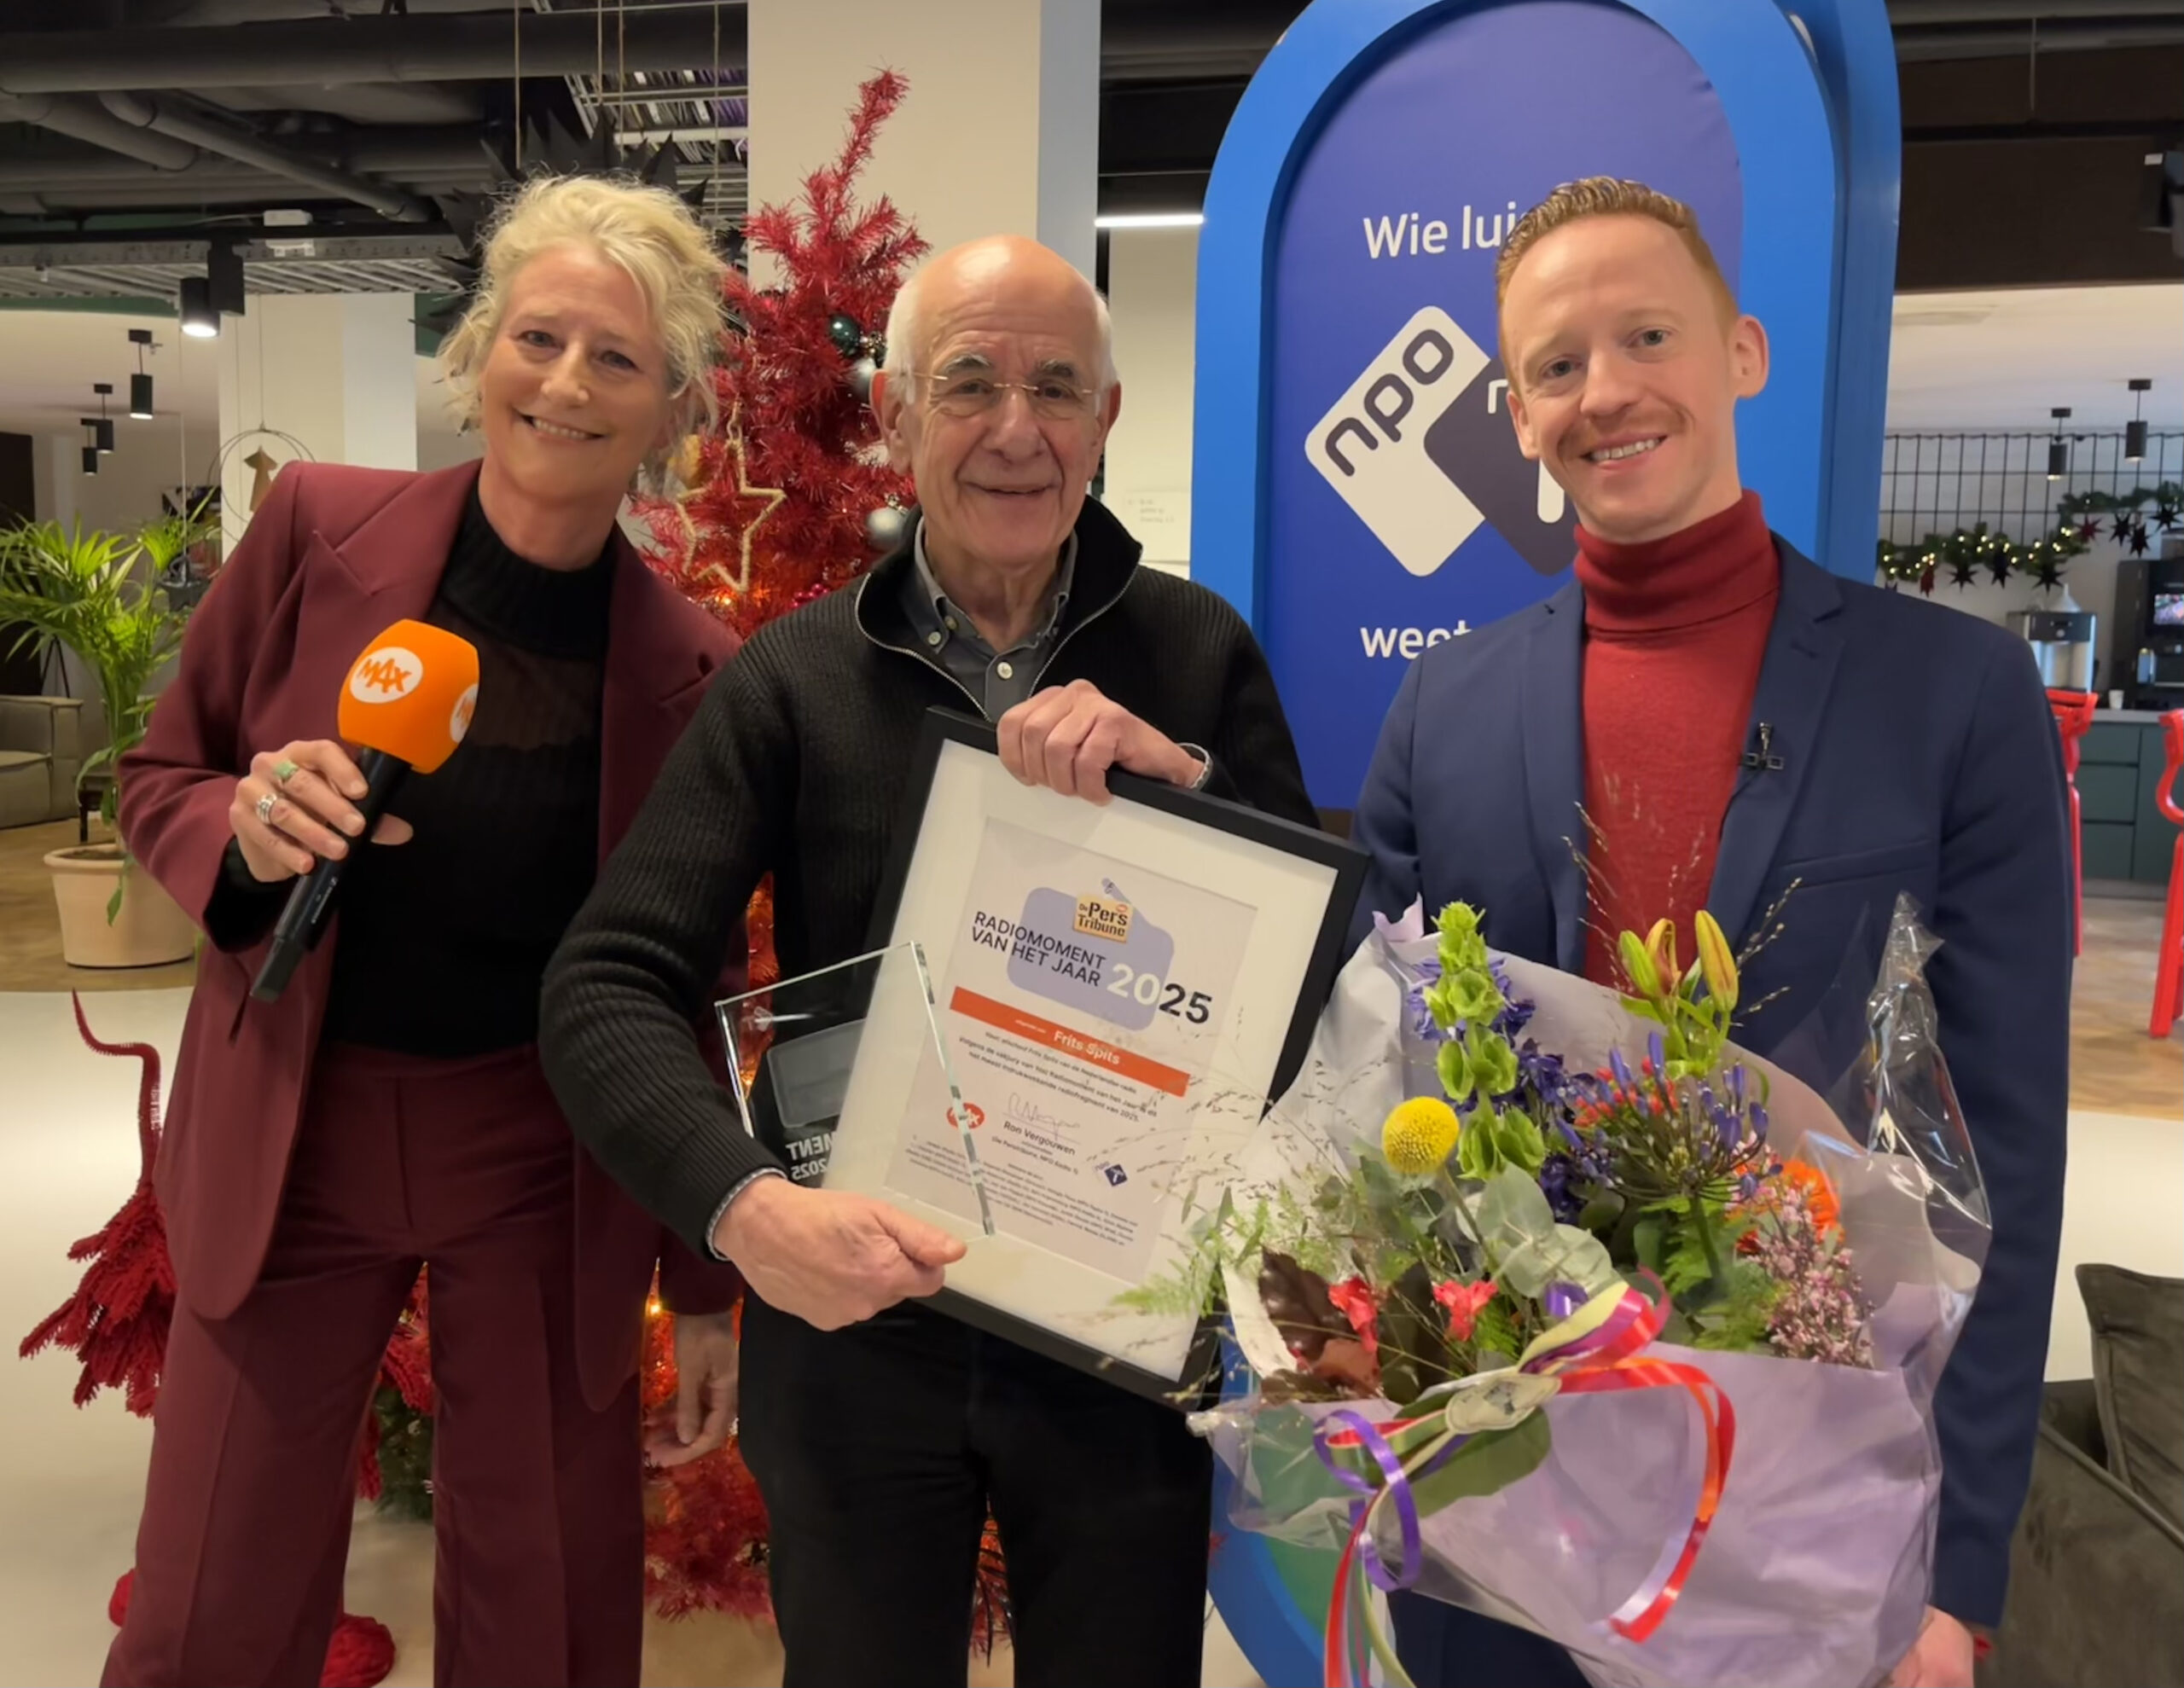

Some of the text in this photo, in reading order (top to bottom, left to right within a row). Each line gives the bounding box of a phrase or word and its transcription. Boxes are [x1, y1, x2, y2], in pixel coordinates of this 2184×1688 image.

[1363, 201, 1519, 258] Wie lui
[1325, 328, 1454, 477] npo
[357, 658, 413, 693] MAX
[1077, 914, 1126, 937] Tribune
[1088, 902, 1129, 926] Pers
[973, 911, 1107, 970] RADIOMOMENT
[971, 927, 1212, 1024] VAN HET JAAR 2025
[1054, 1030, 1120, 1064] Frits Spits
[1002, 1120, 1022, 1134] Ron
[1022, 1128, 1076, 1157] Vergouwen
